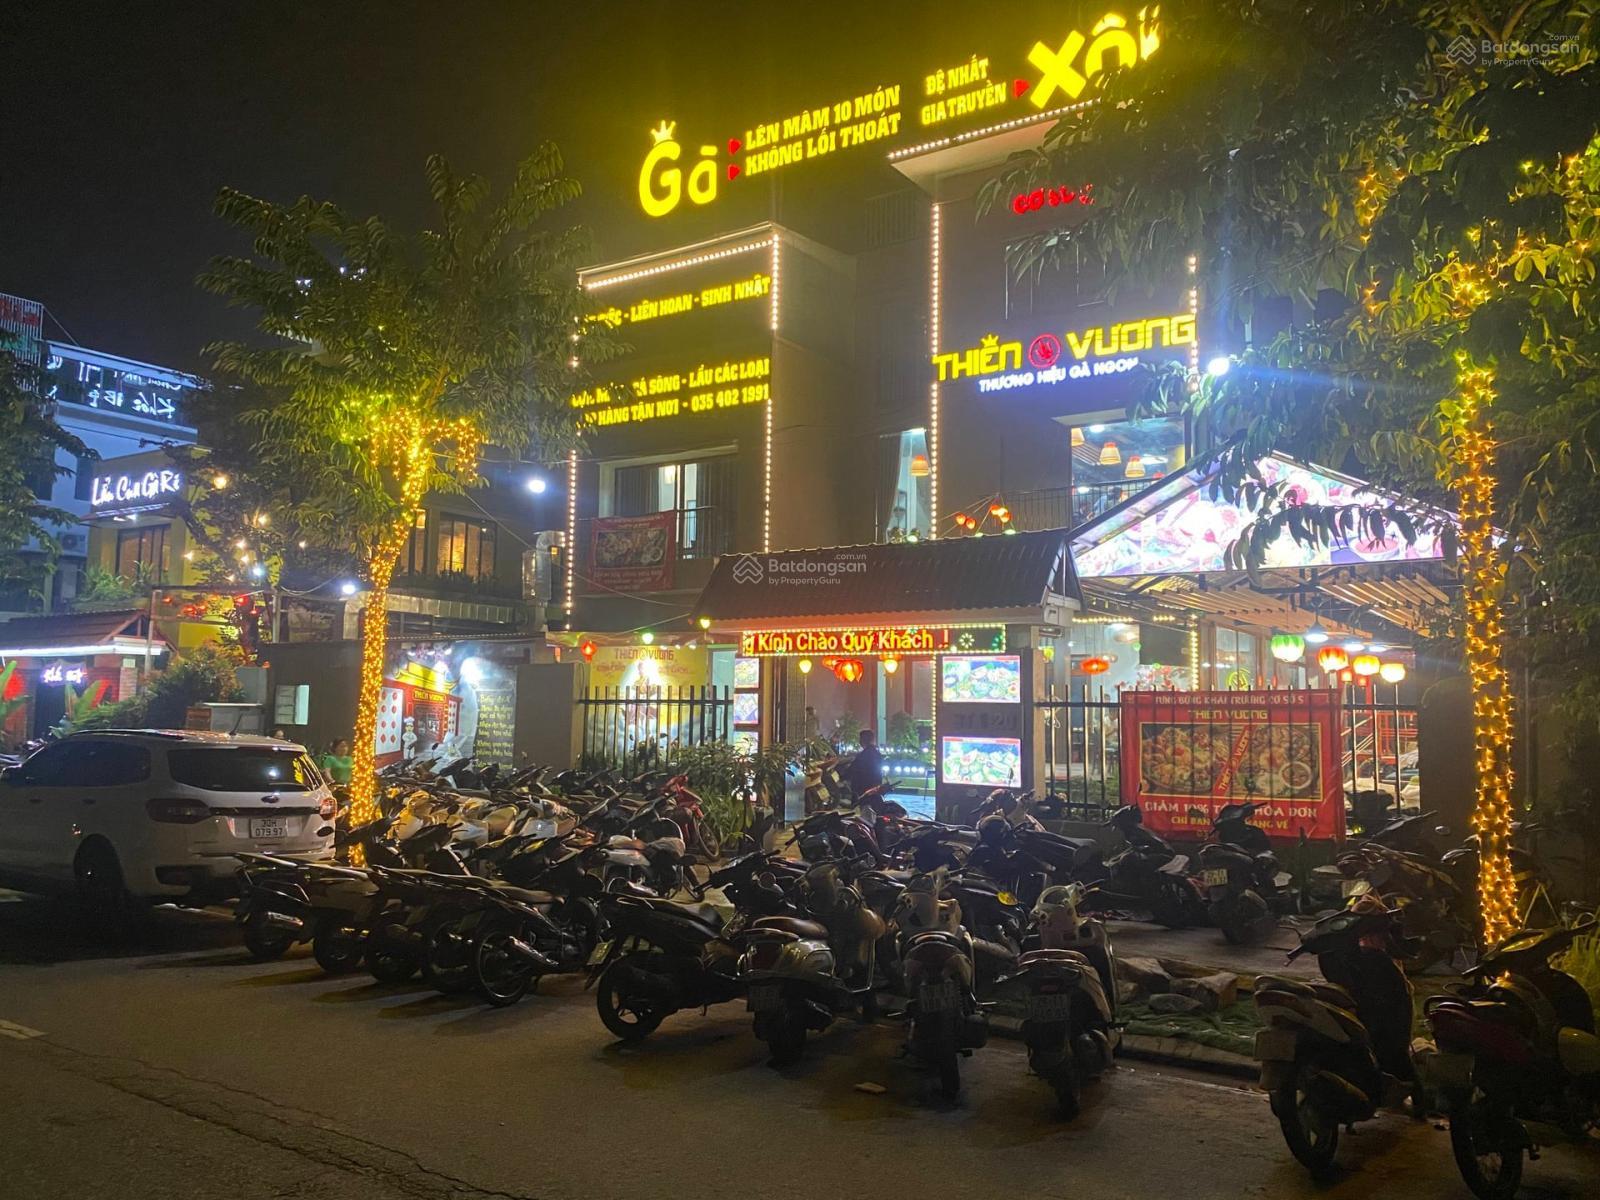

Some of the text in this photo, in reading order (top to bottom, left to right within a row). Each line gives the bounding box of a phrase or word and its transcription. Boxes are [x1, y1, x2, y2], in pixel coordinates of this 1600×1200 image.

[926, 54, 989, 95] ĐỆ NHẤT
[745, 84, 901, 150] LÊN MÂM 10 MÓN
[921, 79, 1007, 125] GIA TRUYỀN
[745, 112, 901, 176] KHÔNG LỐI THOÁT
[639, 140, 718, 216] Gà
[630, 300, 658, 322] LIÊN
[659, 294, 693, 316] HOAN
[701, 285, 732, 307] SINH
[734, 274, 771, 299] NHẬT
[1066, 313, 1196, 360] VƯƠNG
[649, 375, 680, 395] SÔNG
[714, 362, 738, 383] CÁC
[739, 358, 770, 379] LOẠI
[978, 372, 1034, 392] THƯƠNG
[1036, 365, 1067, 385] HIỆU
[1068, 361, 1091, 379] GÀ
[598, 406, 629, 426] HÀNG
[631, 401, 655, 422] TẬN
[656, 398, 680, 417] NƠI
[691, 394, 713, 412] 035
[716, 389, 740, 410] 402
[741, 384, 770, 403] 1991
[758, 632, 793, 651] Kính
[796, 631, 838, 651] Chào
[841, 630, 874, 654] Quý
[878, 629, 933, 650] Khách
[1145, 800, 1179, 812] GIẢM
